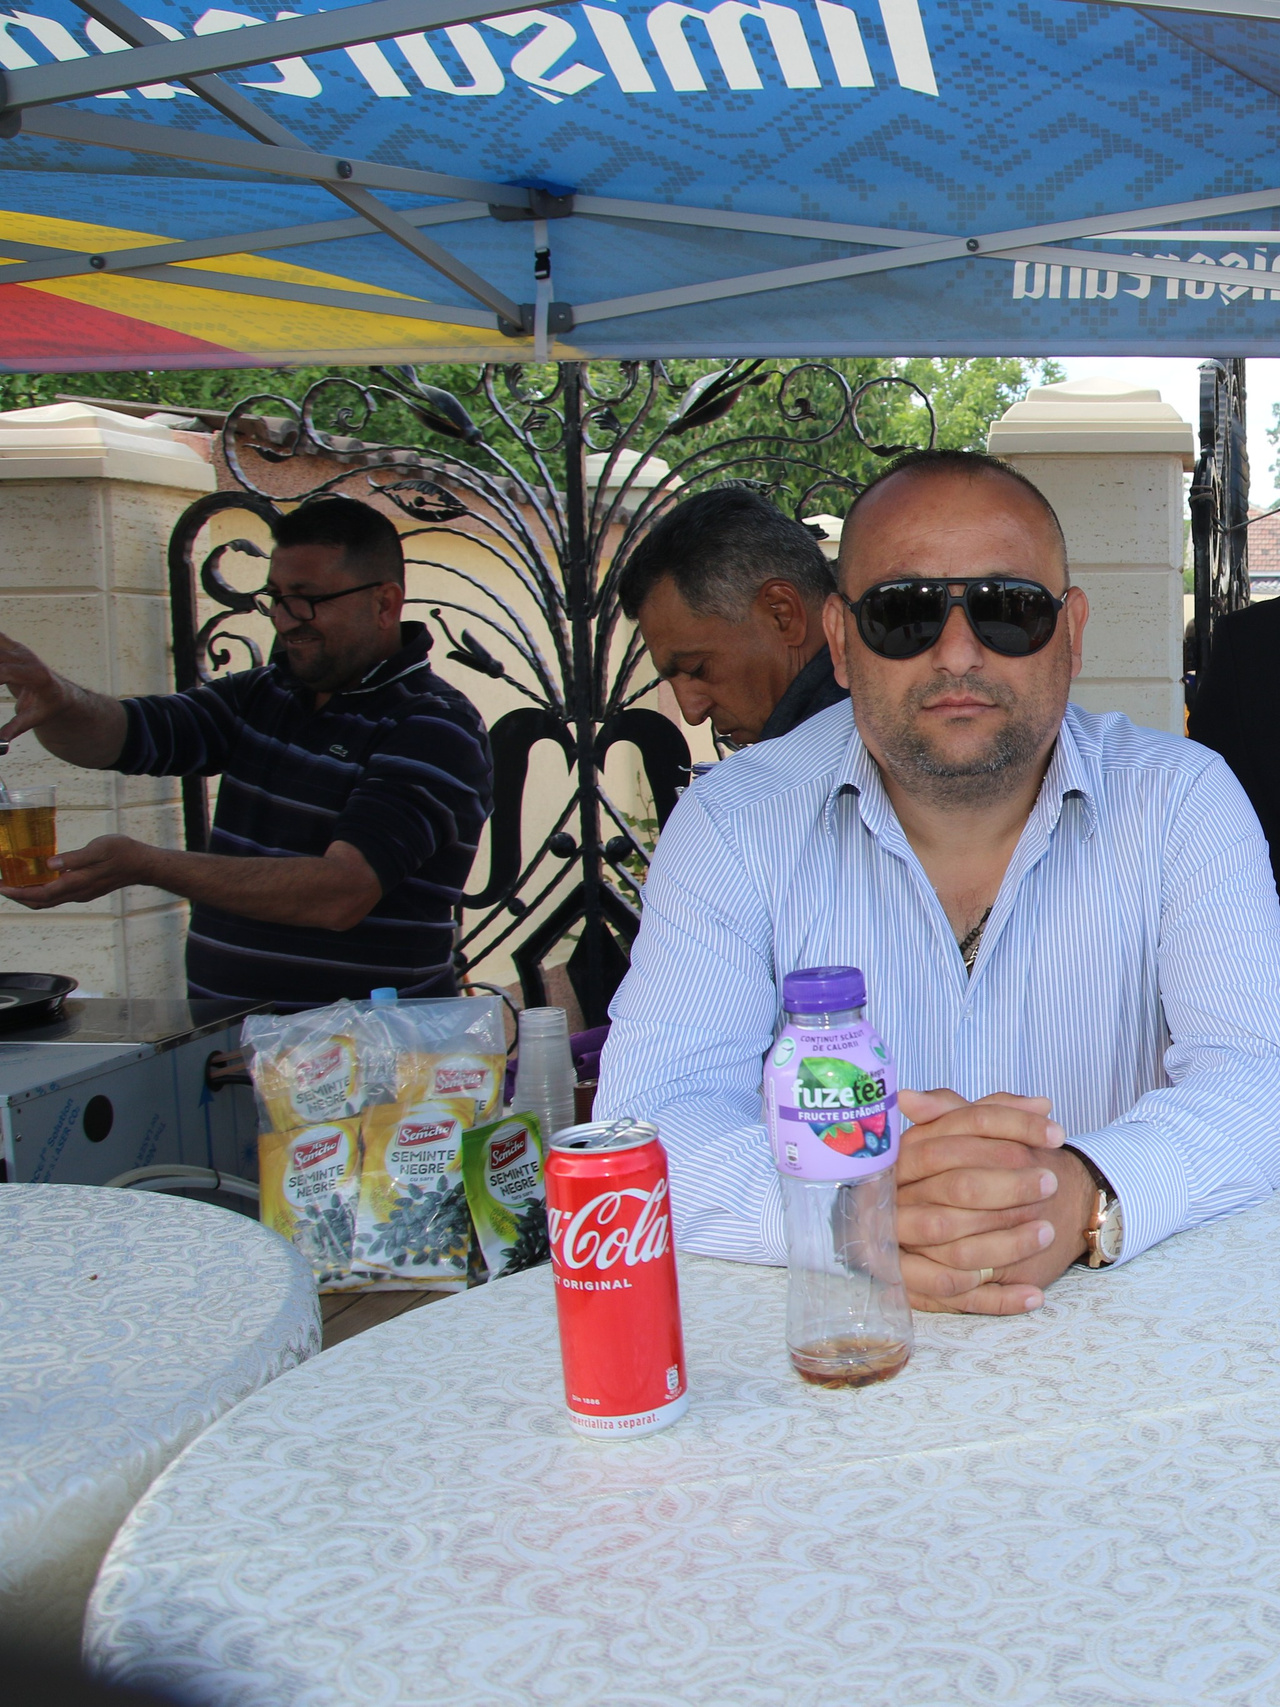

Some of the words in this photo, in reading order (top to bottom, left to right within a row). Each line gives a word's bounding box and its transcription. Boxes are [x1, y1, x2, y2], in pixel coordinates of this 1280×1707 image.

[296, 1075, 350, 1104] SEMINTE
[798, 1111, 840, 1121] FRUCTE
[399, 1125, 450, 1143] Semcho
[294, 1142, 337, 1168] Semcho
[391, 1149, 456, 1162] SEMINTE
[491, 1140, 525, 1166] Semcho
[289, 1164, 345, 1188] SEMINTE
[400, 1162, 445, 1175] NEGRE
[489, 1161, 540, 1187] SEMINTE
[296, 1179, 337, 1199] NEGRE
[500, 1176, 537, 1197] NEGRE
[562, 1278, 632, 1291] ORIGINAL
[617, 1413, 660, 1429] separat.
